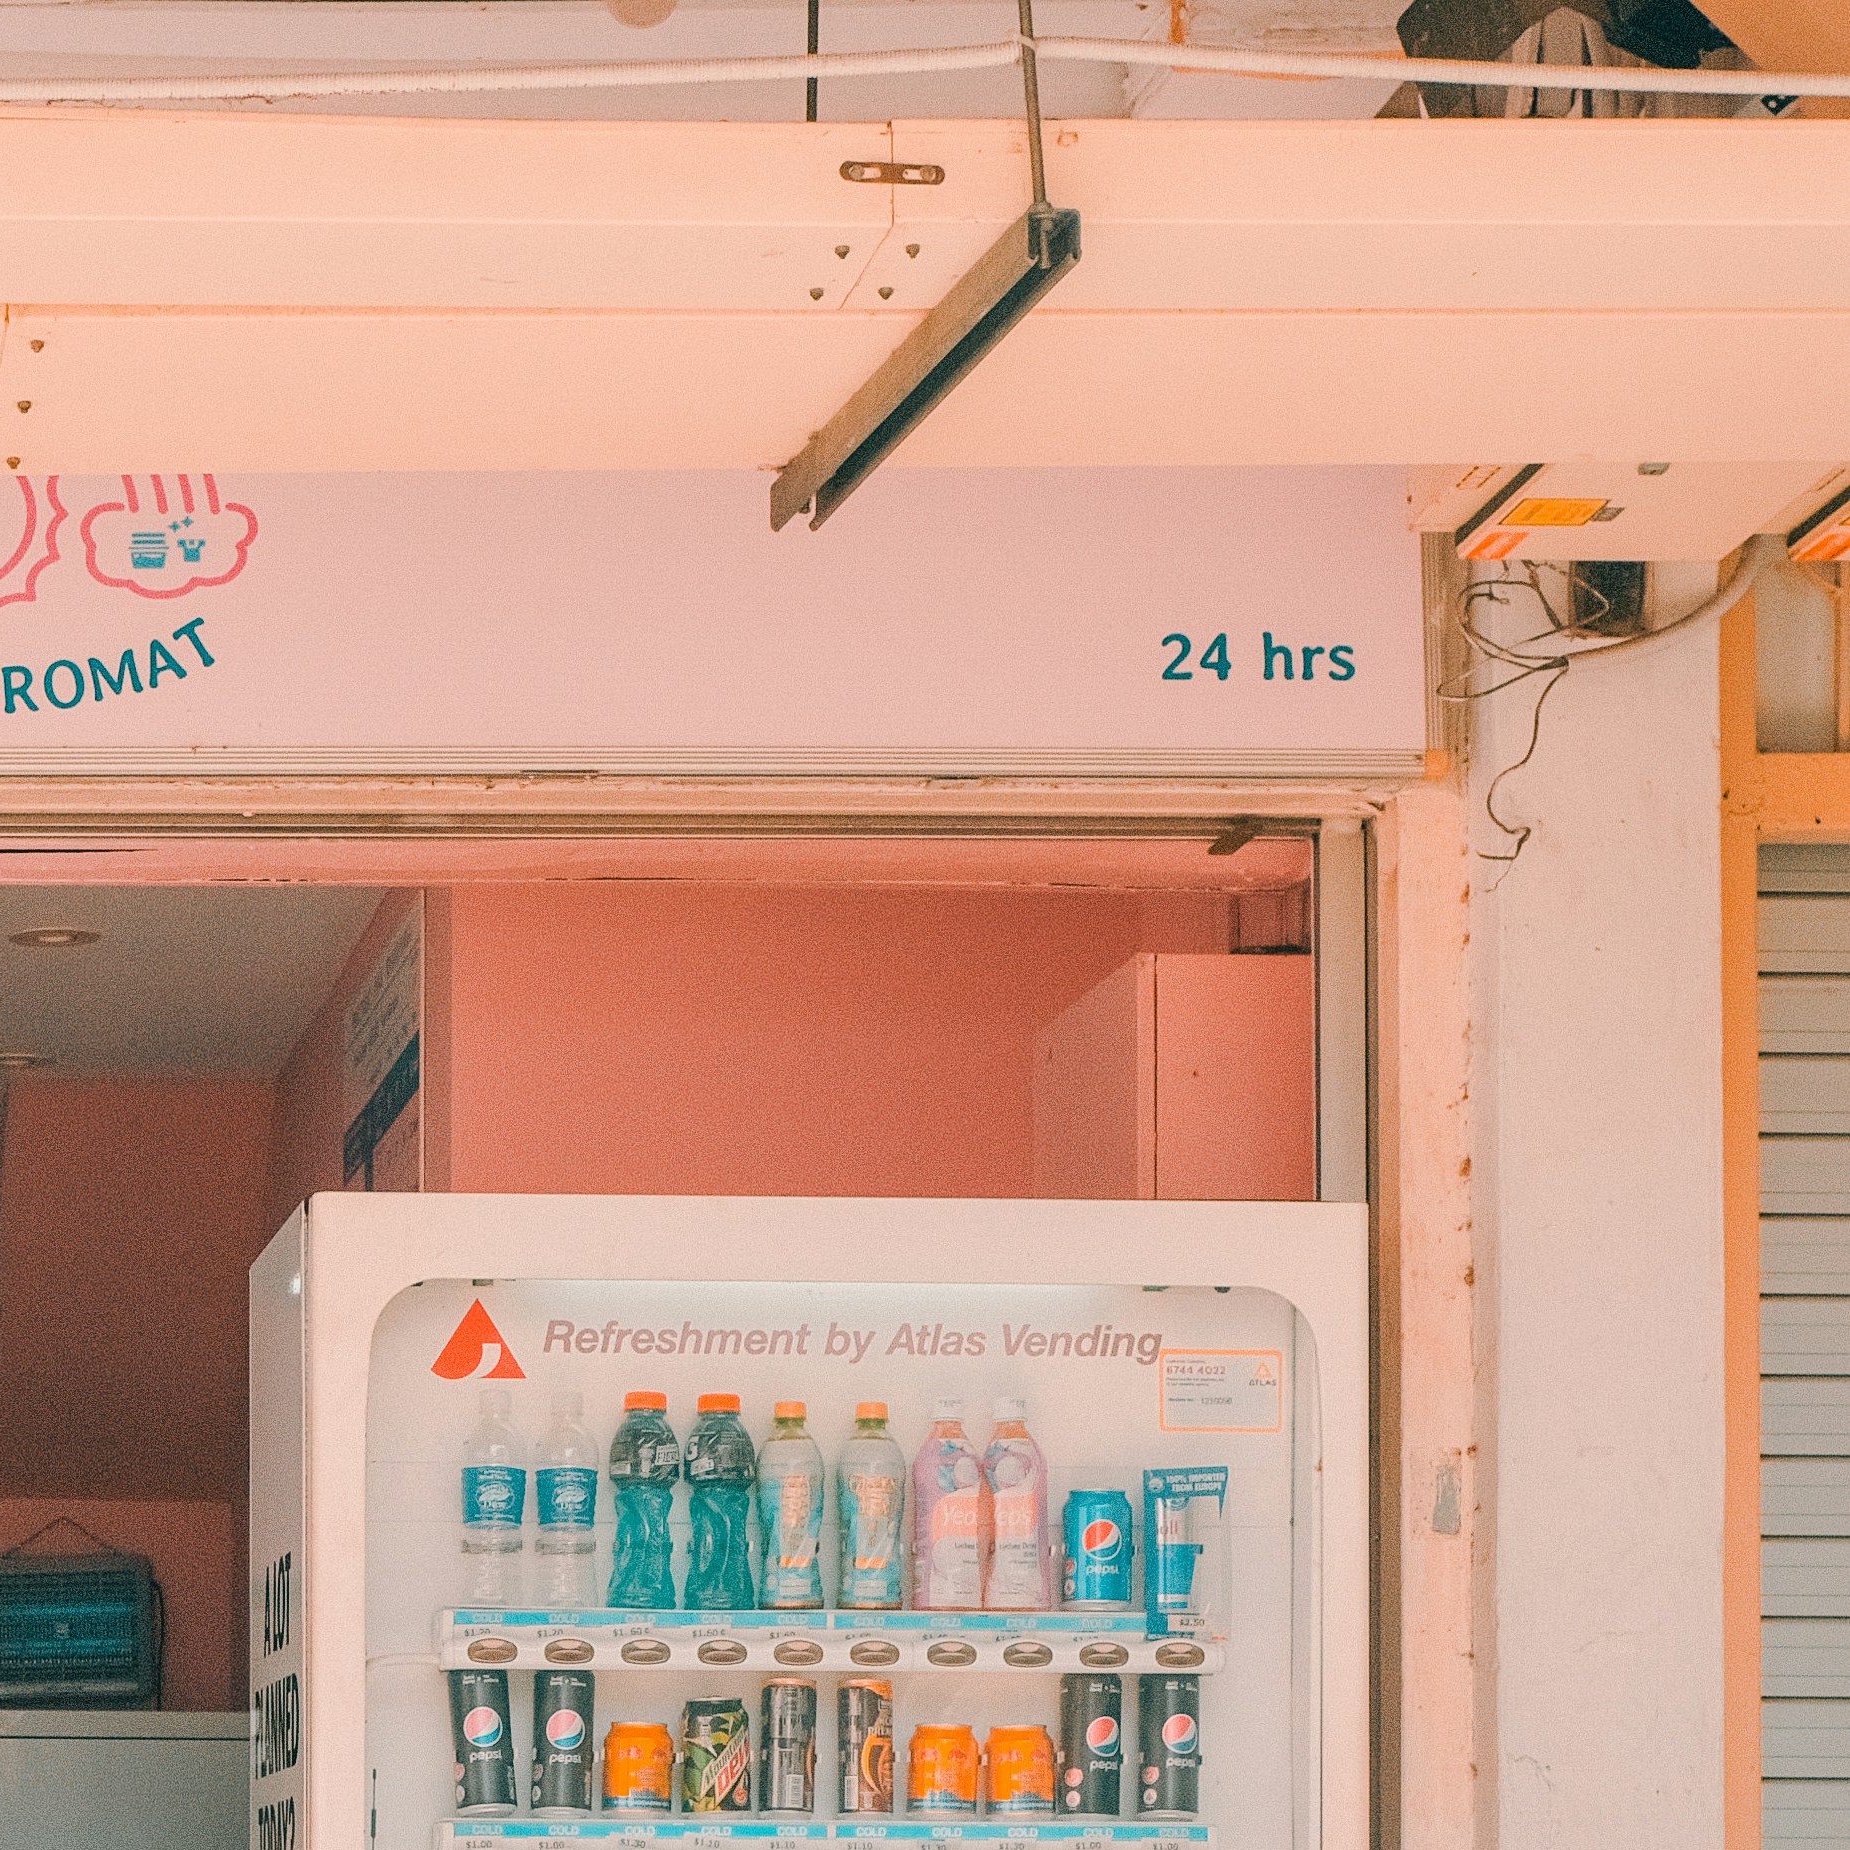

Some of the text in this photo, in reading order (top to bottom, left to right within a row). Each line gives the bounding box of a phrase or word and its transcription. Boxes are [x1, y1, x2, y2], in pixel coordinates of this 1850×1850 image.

[1161, 632, 1356, 681] 24 hrs
[543, 1319, 1163, 1366] Refreshment by Atlas Vending
[1085, 1563, 1119, 1577] pepsi
[263, 1552, 292, 1658] A LOT
[255, 1672, 299, 1779] PLANNED
[469, 1749, 502, 1763] pepsi
[549, 1753, 582, 1765] pepsi
[472, 1825, 503, 1835] COLD
[549, 1825, 580, 1835] COLD
[625, 1825, 656, 1835] COLD
[701, 1826, 732, 1836] COLD
[777, 1826, 808, 1836] COLD
[856, 1827, 887, 1837] COLD
[932, 1827, 963, 1837] COLD
[1008, 1828, 1039, 1838] COLD
[466, 1841, 492, 1849] $1.00
[538, 1841, 565, 1850] $1.00
[1075, 1841, 1102, 1850] $1.00
